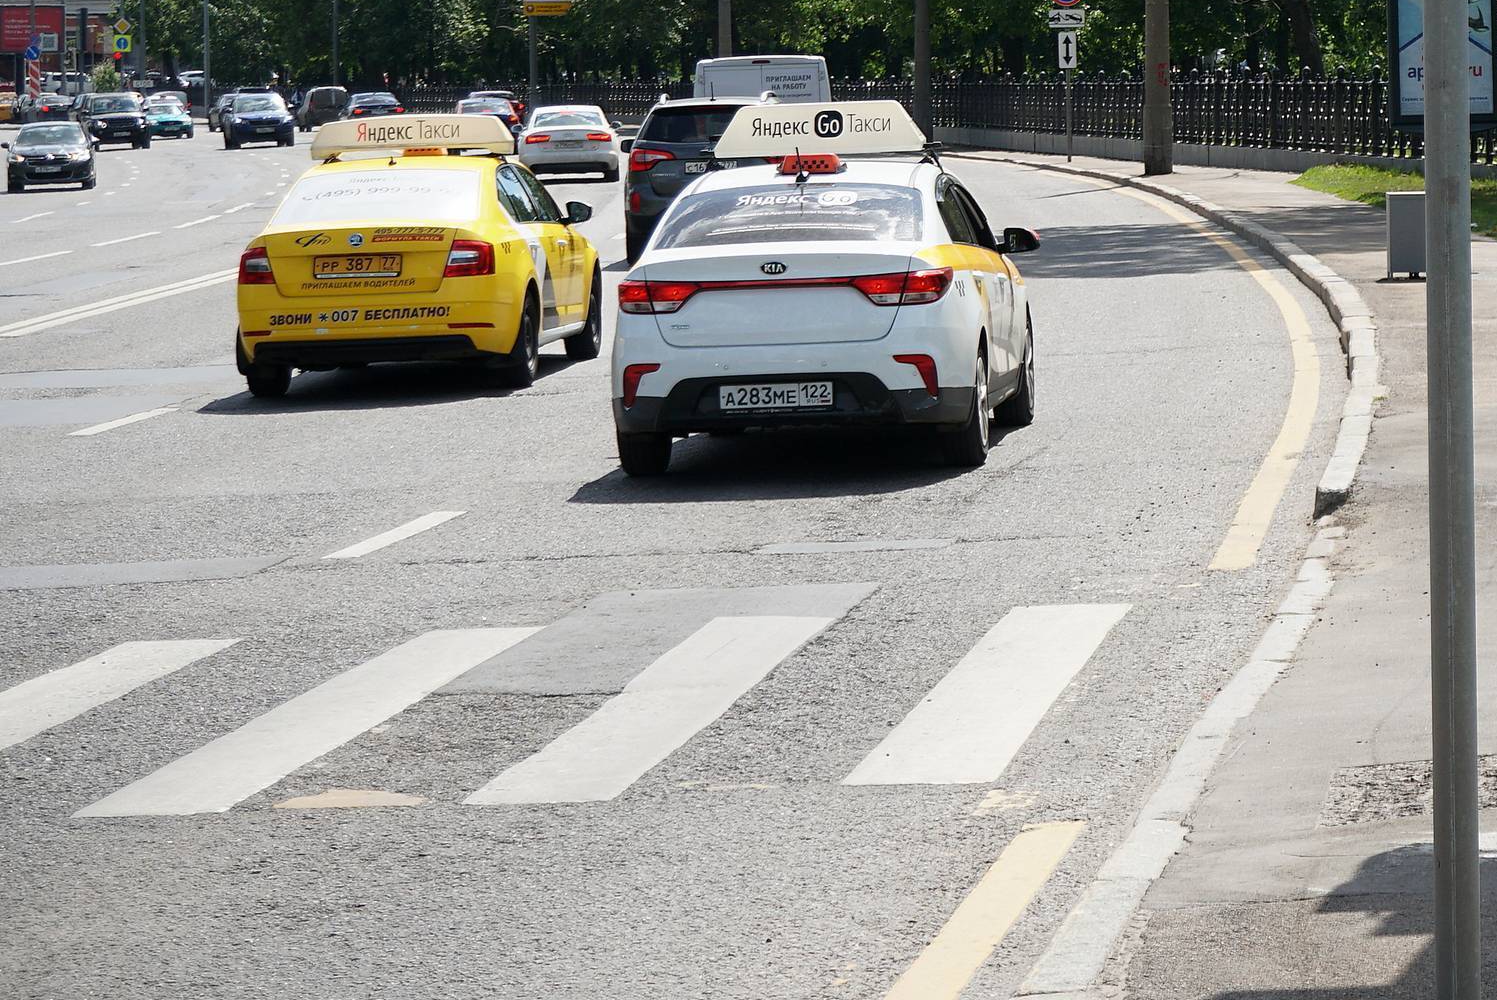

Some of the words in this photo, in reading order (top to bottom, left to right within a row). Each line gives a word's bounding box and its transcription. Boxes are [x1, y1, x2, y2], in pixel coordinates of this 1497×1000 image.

[771, 83, 781, 91] НА
[782, 82, 807, 91] РАБОТУ
[752, 117, 809, 138] Яндекс
[816, 113, 841, 135] Go
[847, 113, 891, 133] Такси
[357, 122, 413, 143] Яндекс
[416, 119, 460, 139] Такси
[735, 194, 811, 207] Яндекс
[345, 257, 374, 271] 387
[382, 256, 397, 267] 77
[763, 263, 785, 273] KIA
[301, 280, 362, 290] ПРИГЛАШАЕМ
[364, 278, 416, 289] ВОДИТЕЛЕЙ
[269, 313, 312, 326] ЗВОНИ
[364, 306, 451, 321] БЕСПЛАТНО!
[801, 383, 828, 398] 122
